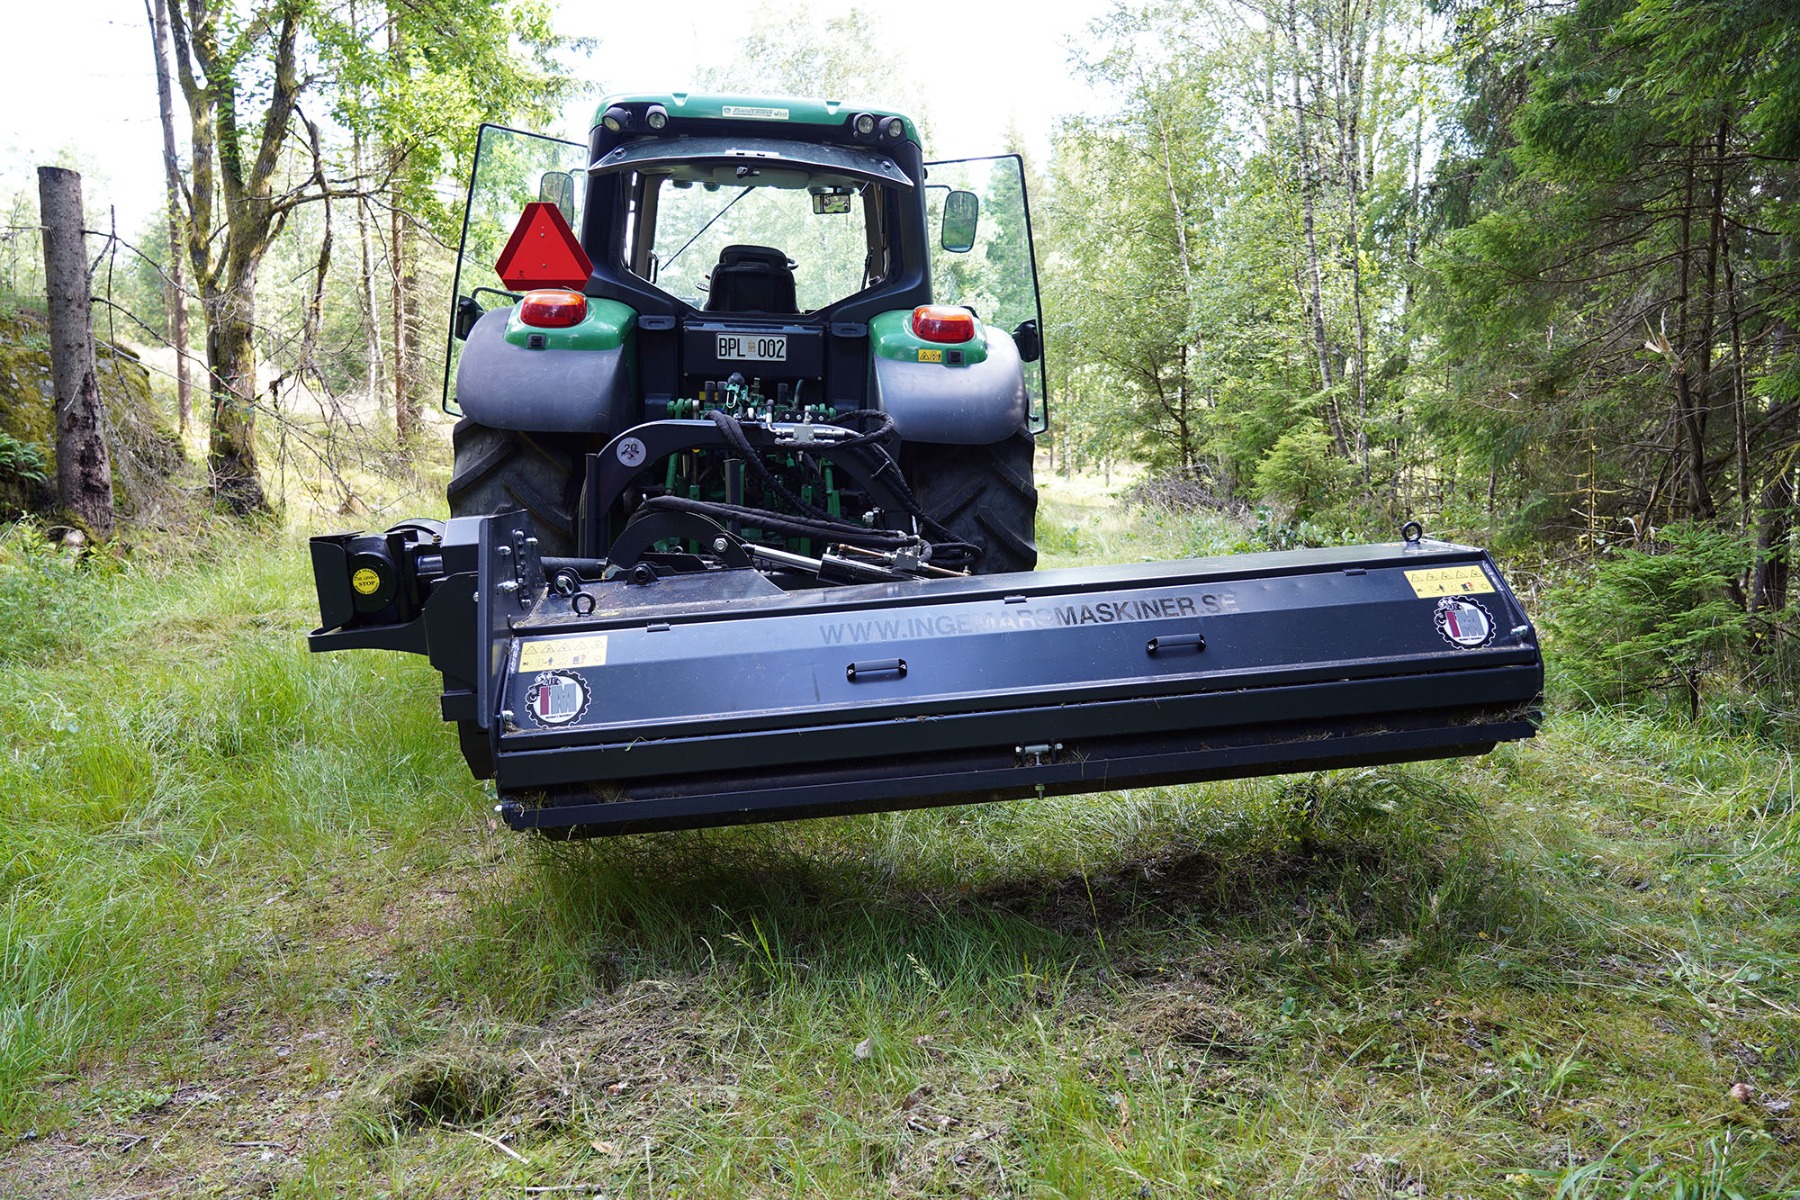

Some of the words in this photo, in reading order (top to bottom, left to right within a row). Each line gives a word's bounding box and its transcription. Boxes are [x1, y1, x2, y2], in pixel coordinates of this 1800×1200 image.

[719, 338, 746, 357] BPL
[758, 339, 785, 358] 002
[624, 443, 637, 452] 20
